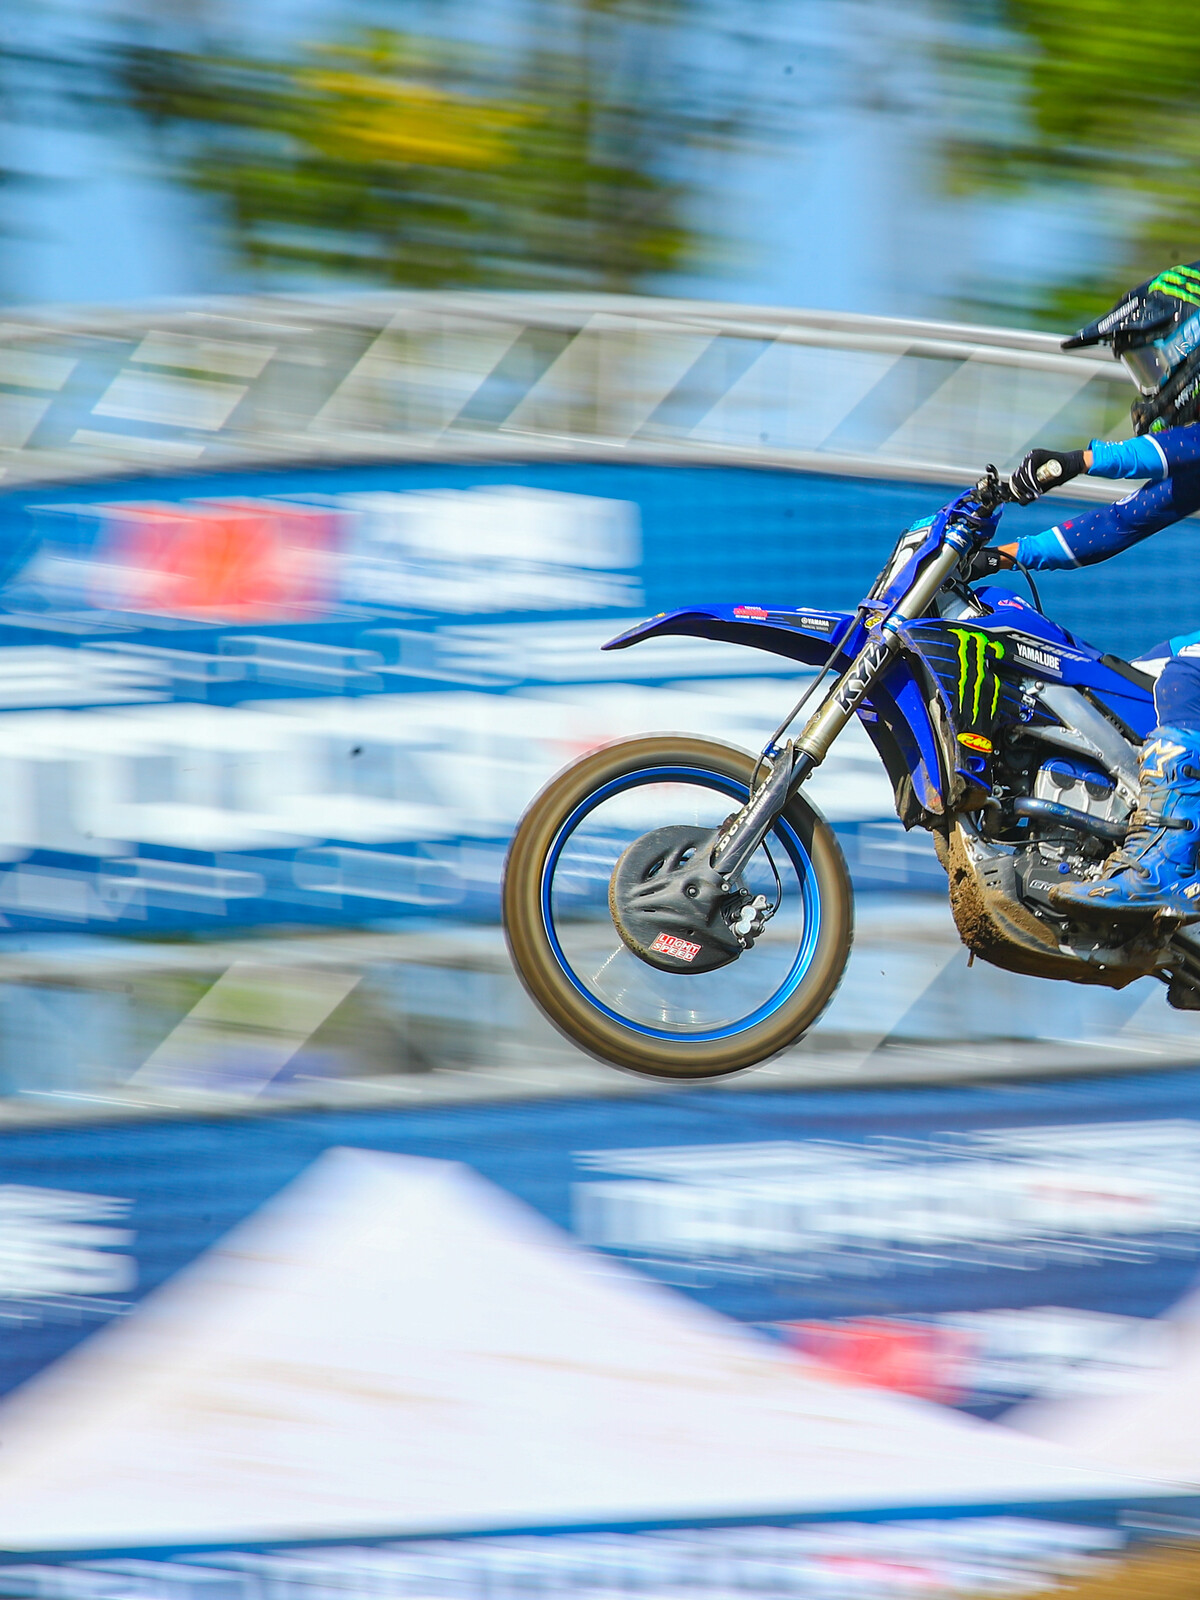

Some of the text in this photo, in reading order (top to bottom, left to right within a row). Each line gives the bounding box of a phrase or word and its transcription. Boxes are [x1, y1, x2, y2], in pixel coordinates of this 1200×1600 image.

[807, 617, 830, 627] YAMAHA
[1016, 643, 1061, 671] YAMALUBE
[651, 942, 695, 962] SPEED
[658, 933, 702, 954] LIGHT
